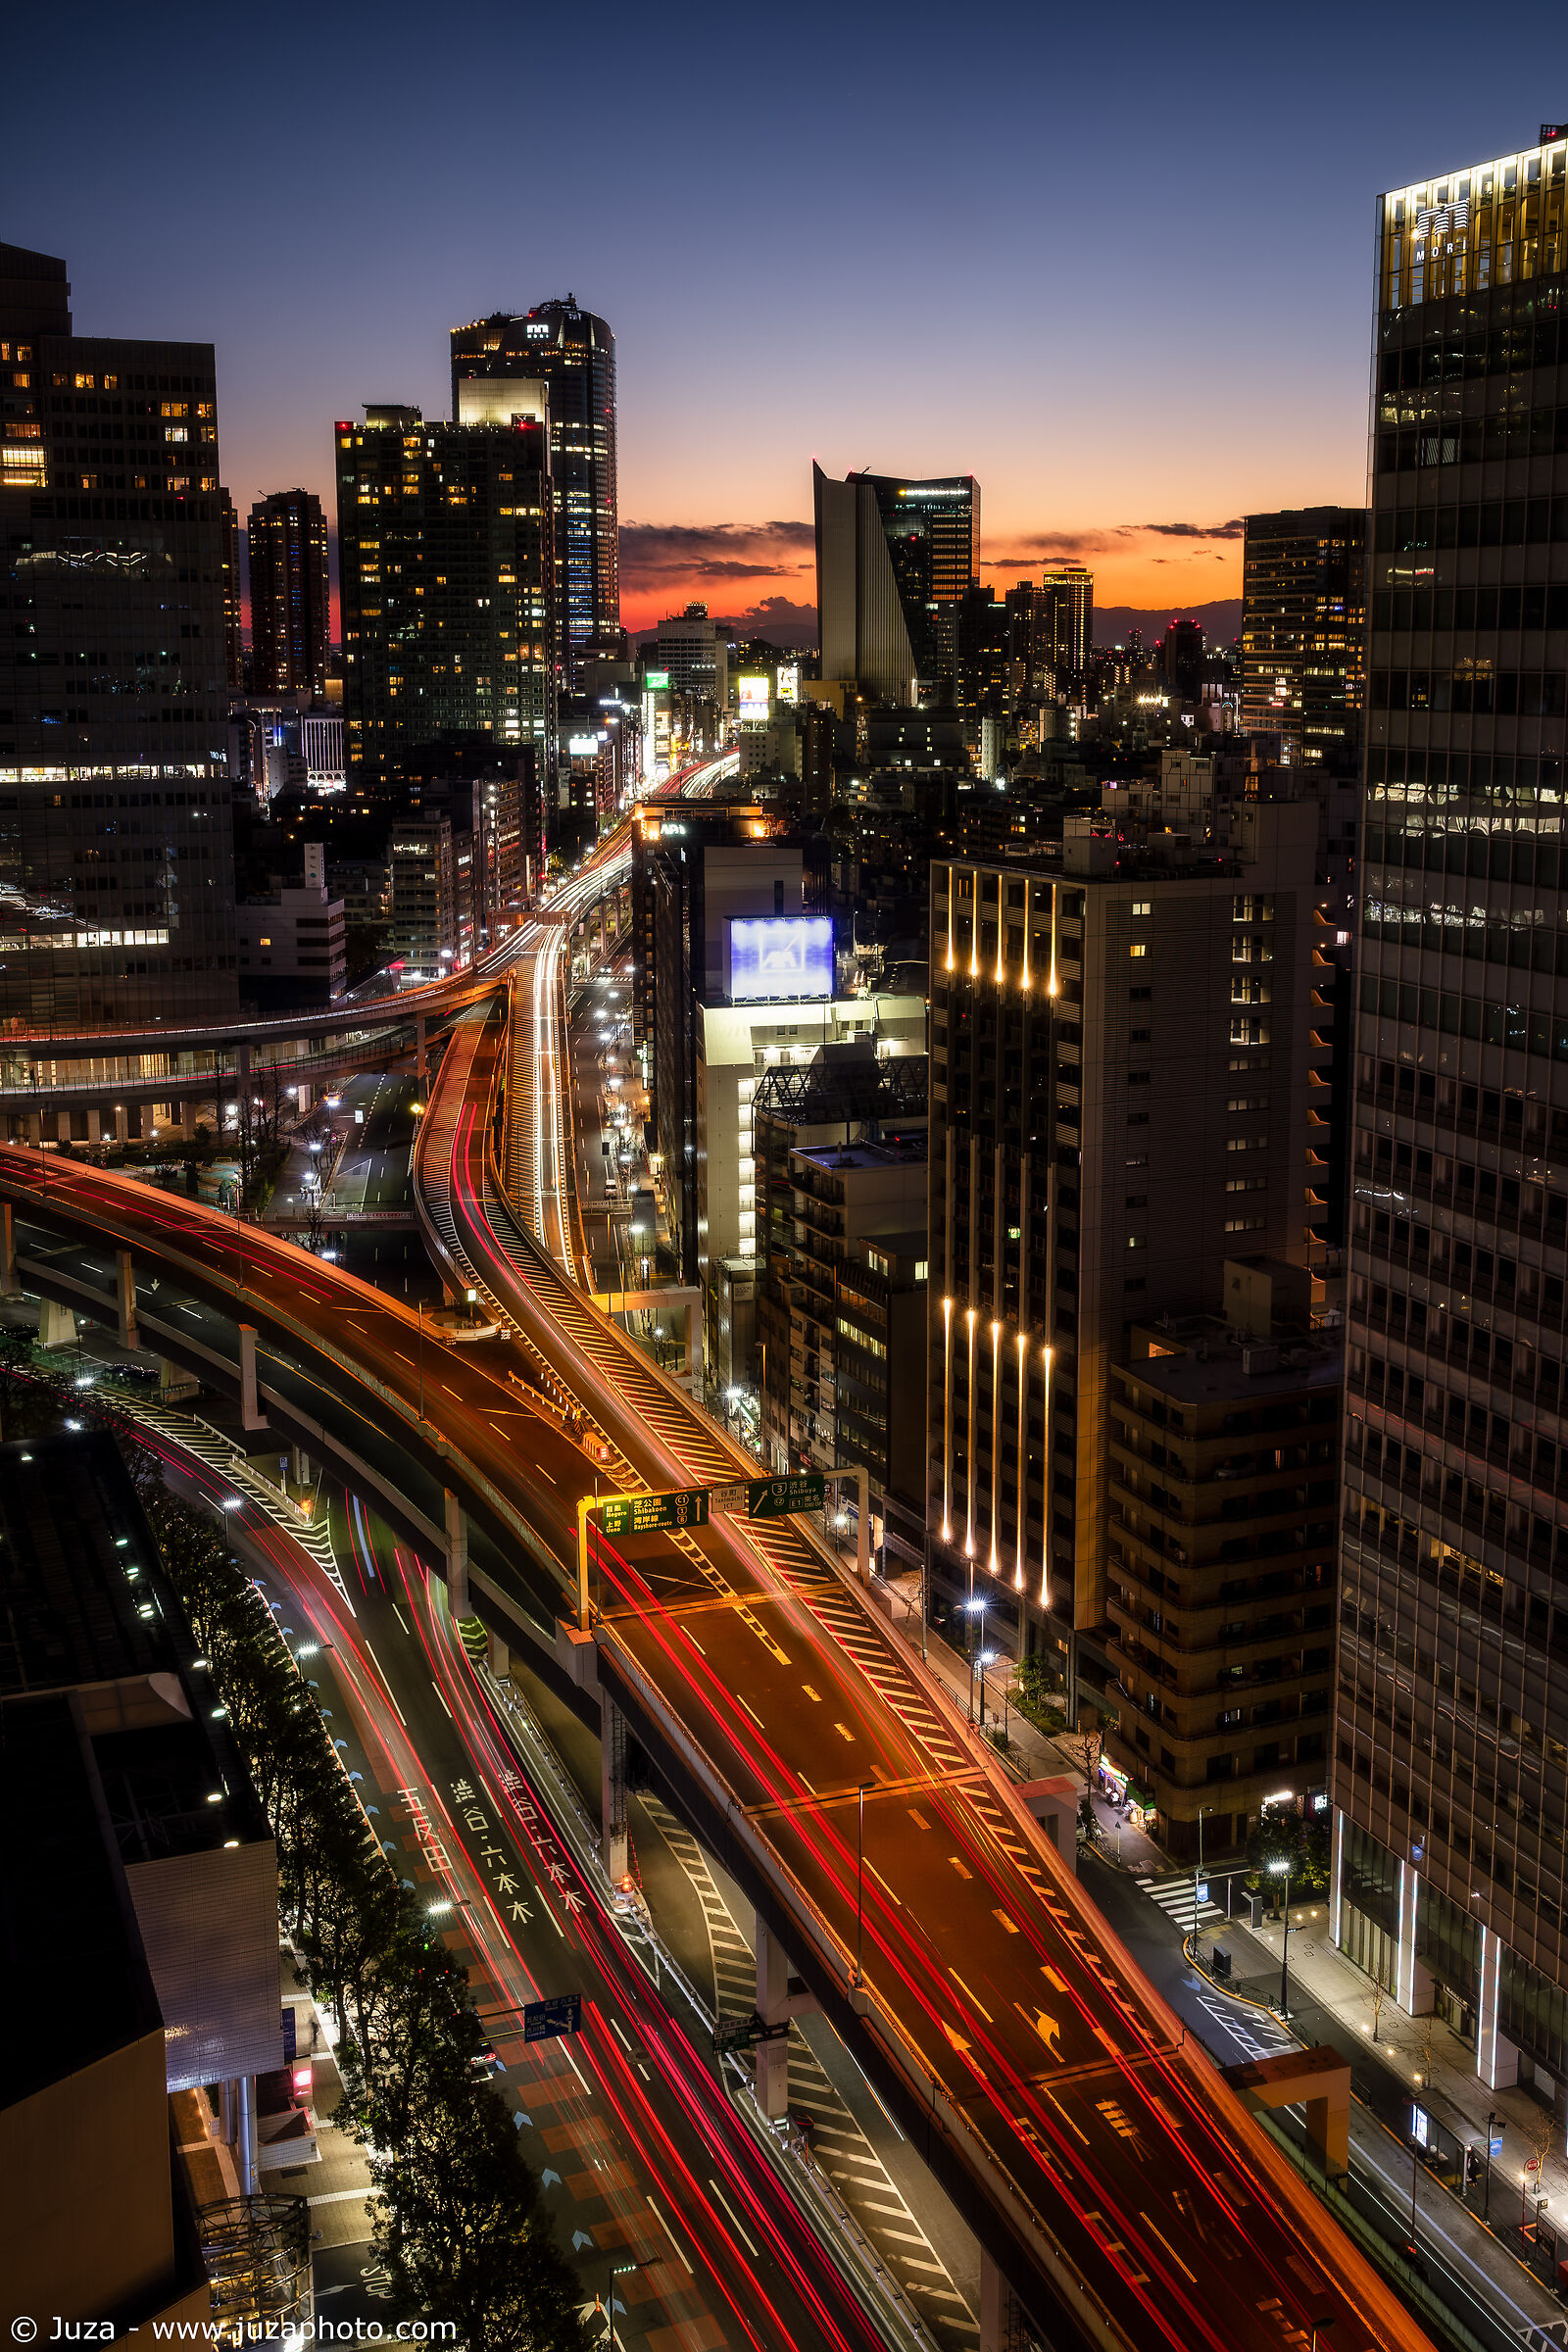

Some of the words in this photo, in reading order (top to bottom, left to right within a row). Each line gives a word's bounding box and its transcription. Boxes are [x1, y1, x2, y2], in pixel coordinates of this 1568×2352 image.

[1416, 239, 1467, 262] MORI
[789, 1480, 808, 1490] 渋谷
[634, 1497, 662, 1509] 芝公園
[634, 1505, 666, 1515] Shibakoen
[396, 1787, 453, 1873] 五反田
